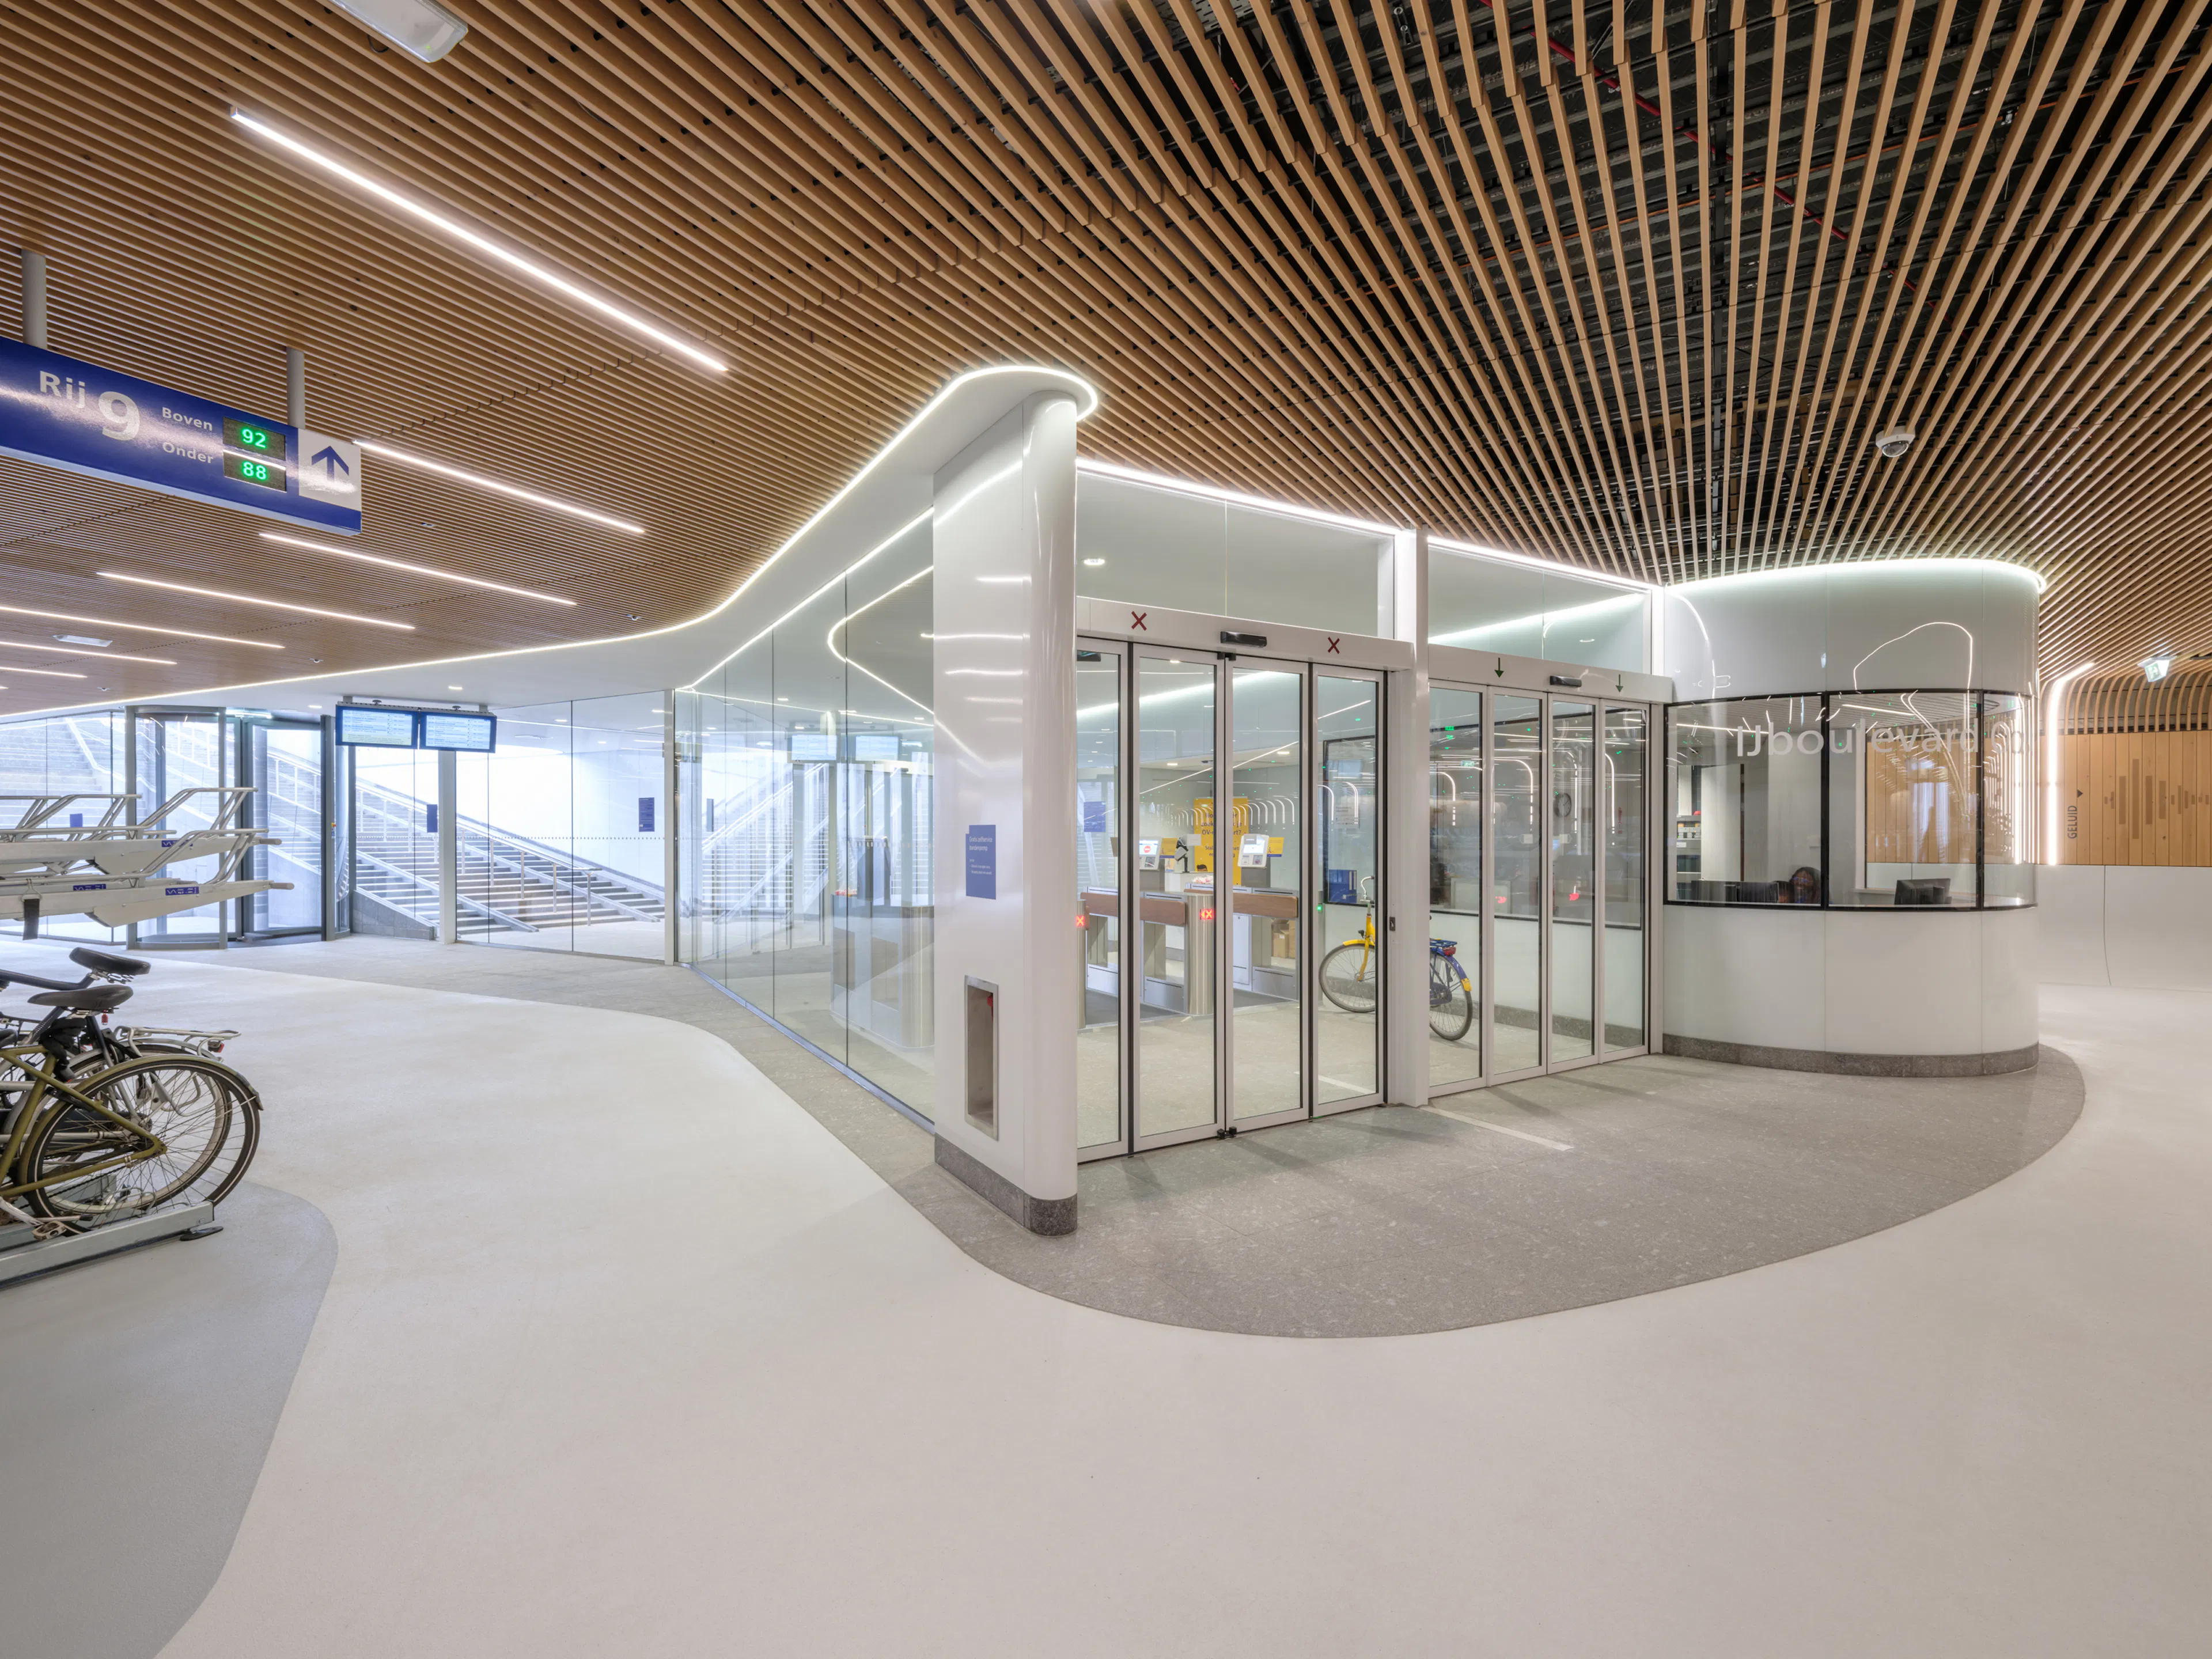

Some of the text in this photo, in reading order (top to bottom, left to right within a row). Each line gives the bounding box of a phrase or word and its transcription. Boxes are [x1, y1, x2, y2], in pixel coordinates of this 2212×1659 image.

[40, 370, 140, 441] Rij 9
[162, 407, 267, 449] Boven 92
[162, 442, 267, 480] Onder 88
[1737, 718, 1979, 757] IJboulevard
[2067, 805, 2078, 839] GELUID
